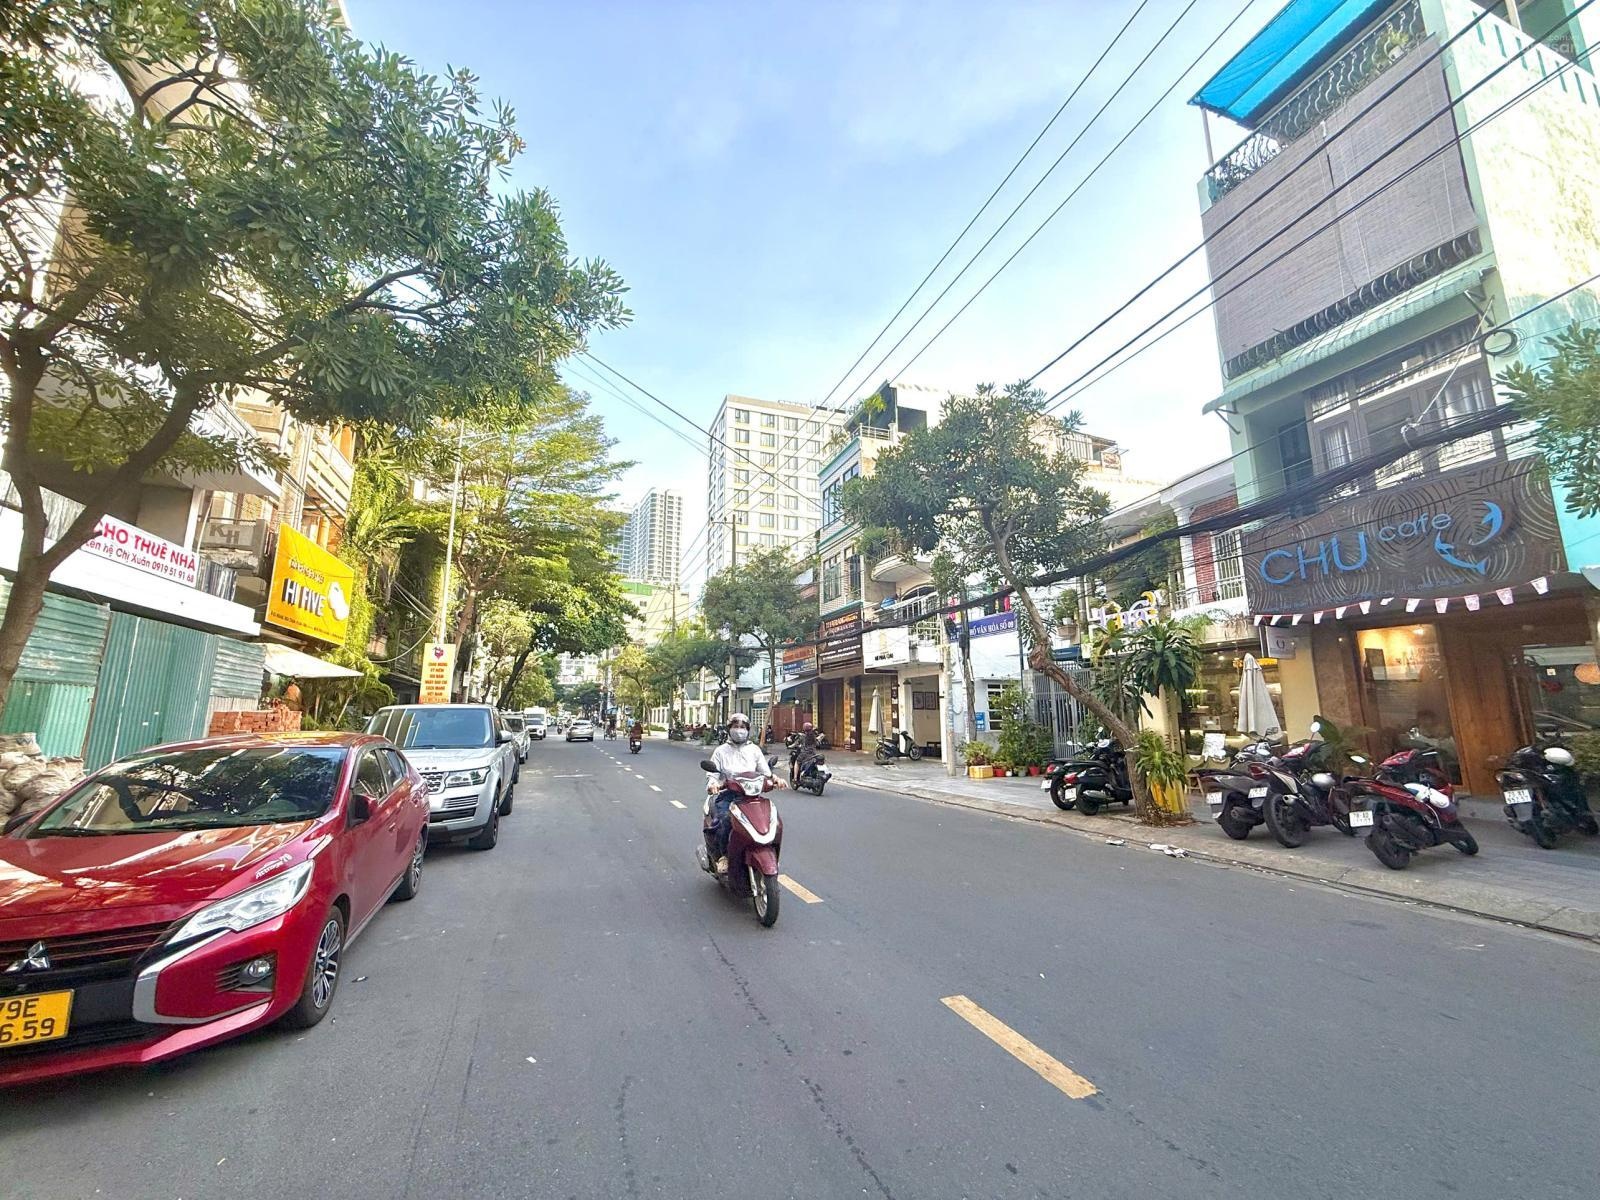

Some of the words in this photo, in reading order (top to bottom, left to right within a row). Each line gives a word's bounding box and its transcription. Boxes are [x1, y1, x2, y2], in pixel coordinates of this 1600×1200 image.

[103, 543, 114, 557] hệ
[116, 548, 130, 563] Chị
[152, 561, 169, 574] 0919
[169, 569, 177, 577] 51
[178, 571, 186, 580] 91
[134, 535, 168, 560] THUÊ
[170, 550, 196, 571] NHÀ
[1260, 531, 1368, 584] CHU
[1378, 512, 1452, 541] cafe
[282, 578, 302, 606] HI
[301, 586, 326, 617] FIVE
[0, 998, 39, 1020] 79E
